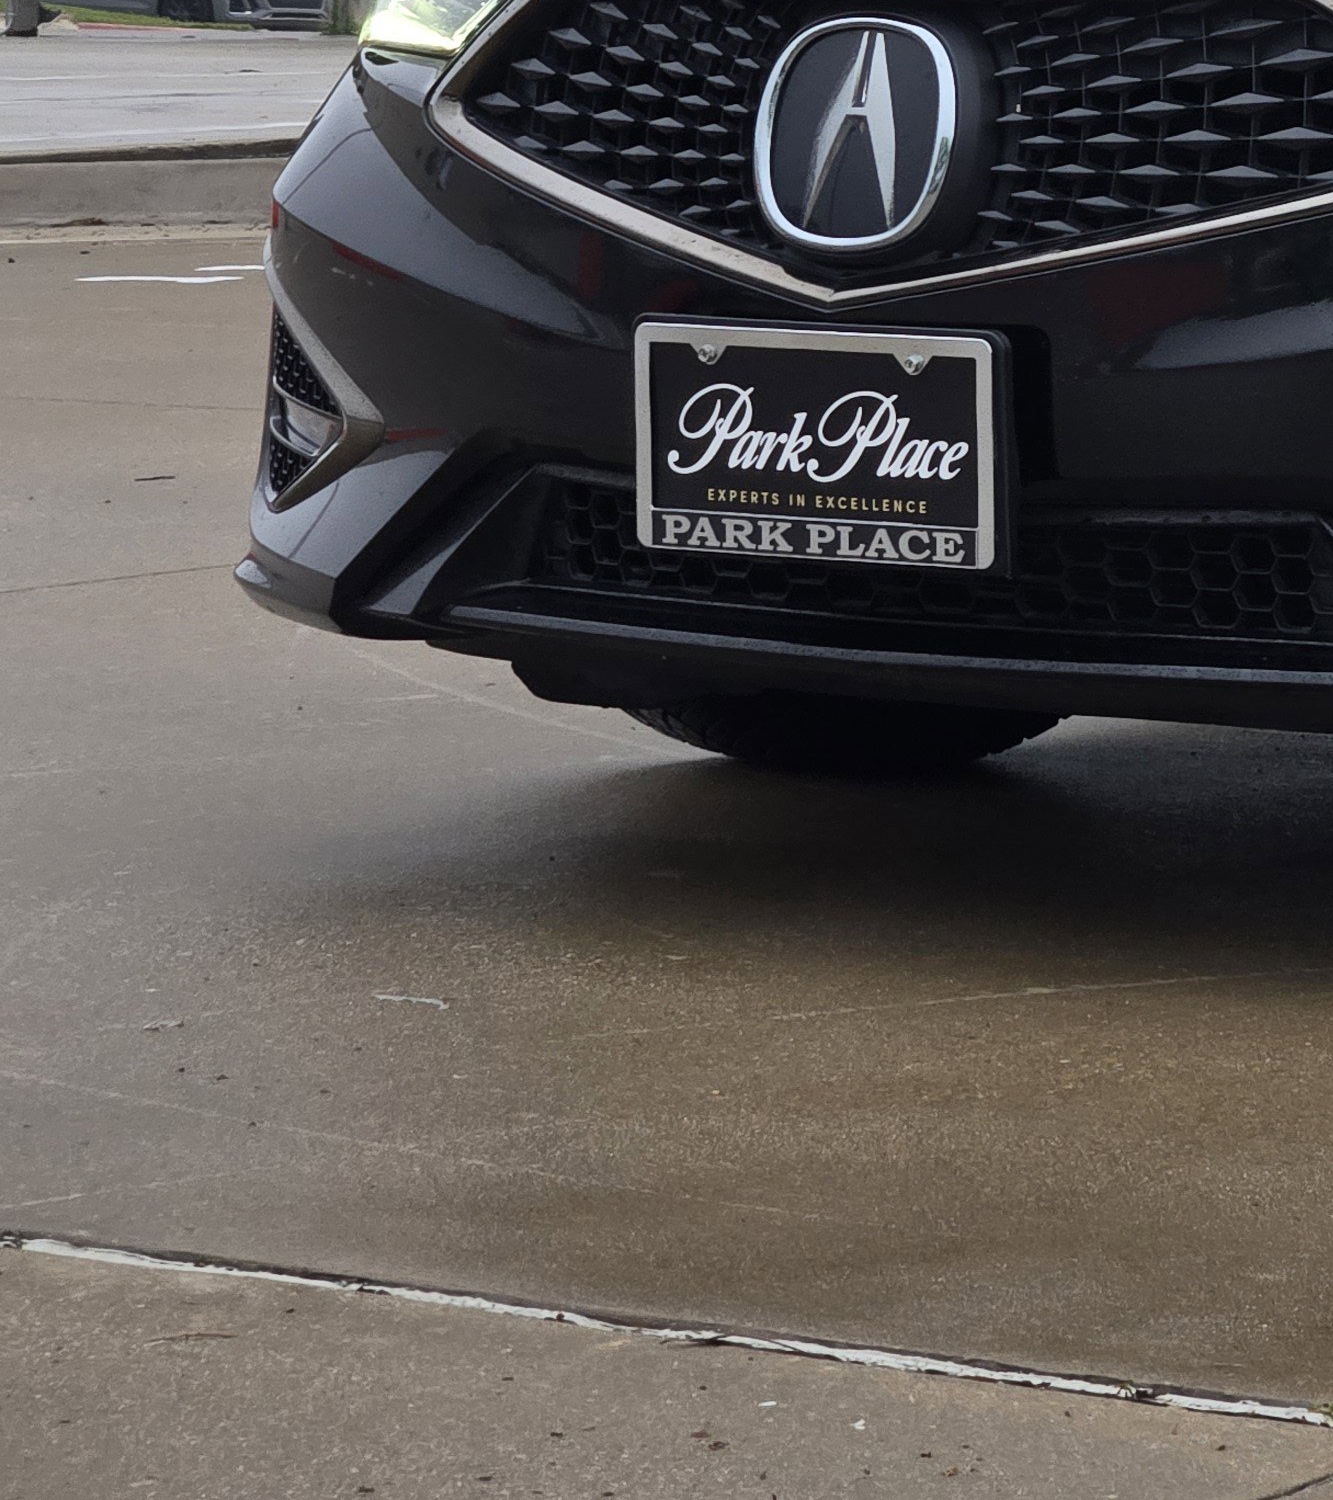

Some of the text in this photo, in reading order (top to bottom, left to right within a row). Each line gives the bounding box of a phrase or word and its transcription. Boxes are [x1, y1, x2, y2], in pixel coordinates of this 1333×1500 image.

[667, 382, 970, 483] Park Place
[706, 487, 928, 514] EXPERTS IN EXCELLENCE
[661, 514, 966, 563] PARK PLACE
